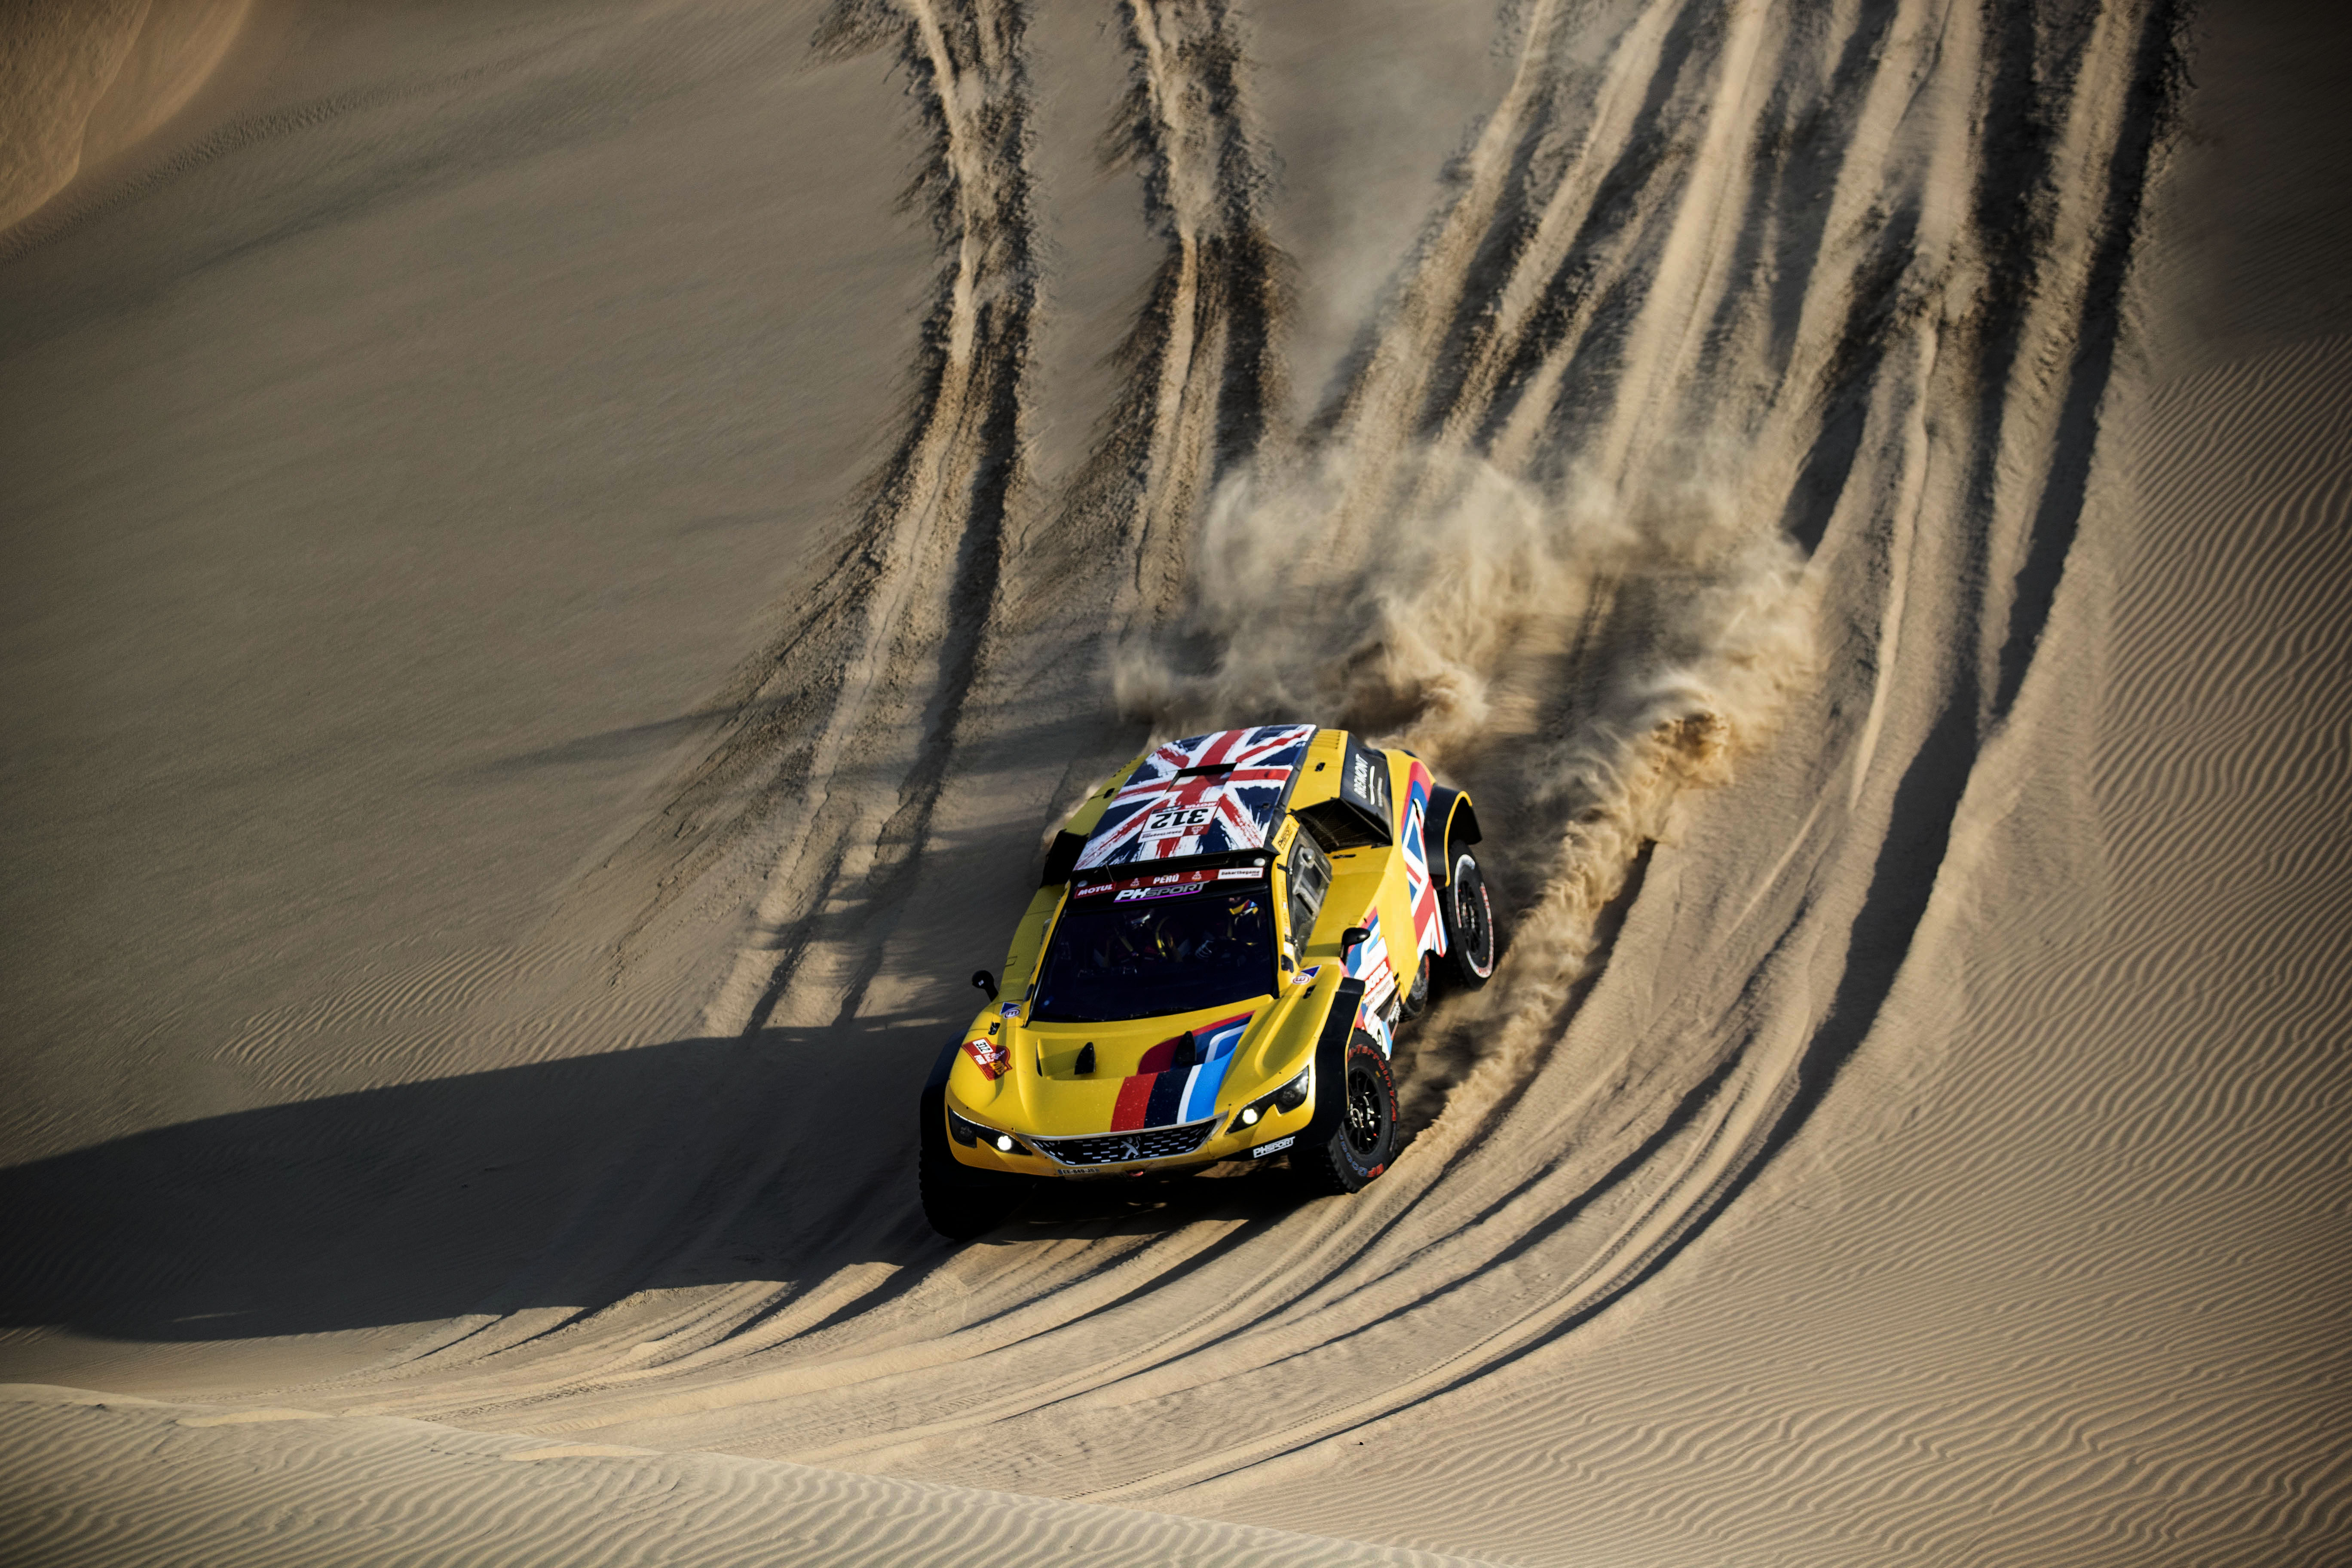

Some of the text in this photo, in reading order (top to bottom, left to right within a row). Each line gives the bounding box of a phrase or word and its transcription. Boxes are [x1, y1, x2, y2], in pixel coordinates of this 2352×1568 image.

[1151, 808, 1209, 829] 312
[1077, 884, 1113, 896] MOTUL
[976, 1042, 991, 1052] 312
